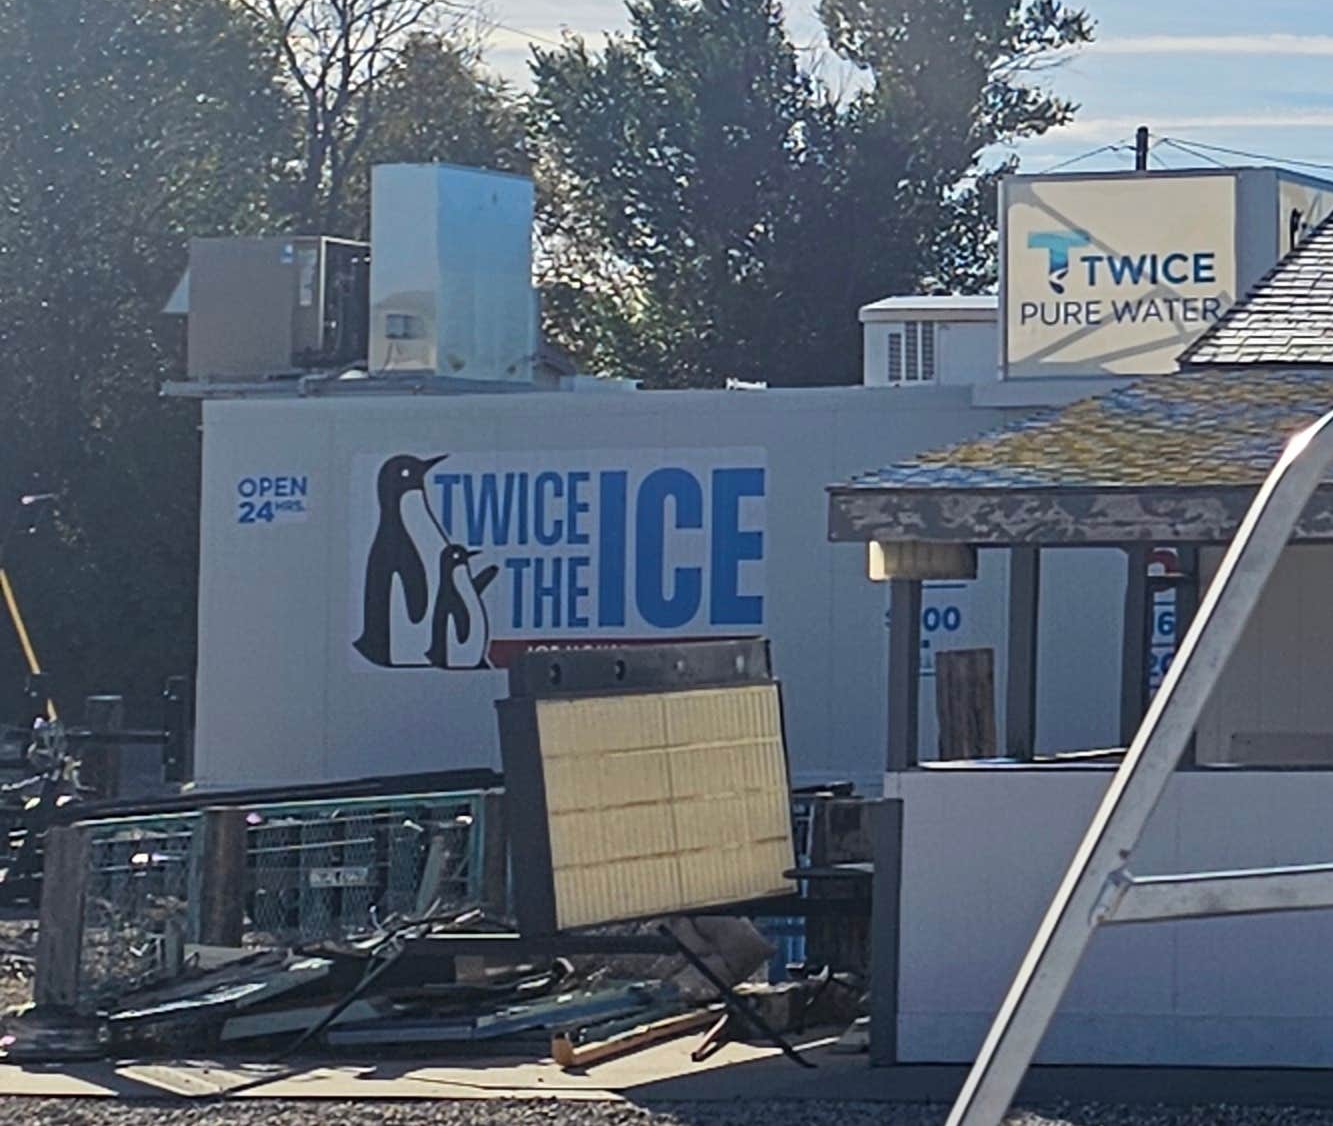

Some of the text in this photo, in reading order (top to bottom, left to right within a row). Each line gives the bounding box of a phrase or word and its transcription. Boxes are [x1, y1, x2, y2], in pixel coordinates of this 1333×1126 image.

[1080, 252, 1216, 286] TWICE
[1021, 297, 1222, 325] PURE WATER
[237, 476, 307, 497] OPEN
[238, 500, 274, 523] 24
[434, 470, 591, 547] TWICE
[597, 467, 766, 629] ICE
[505, 556, 591, 629] THE
